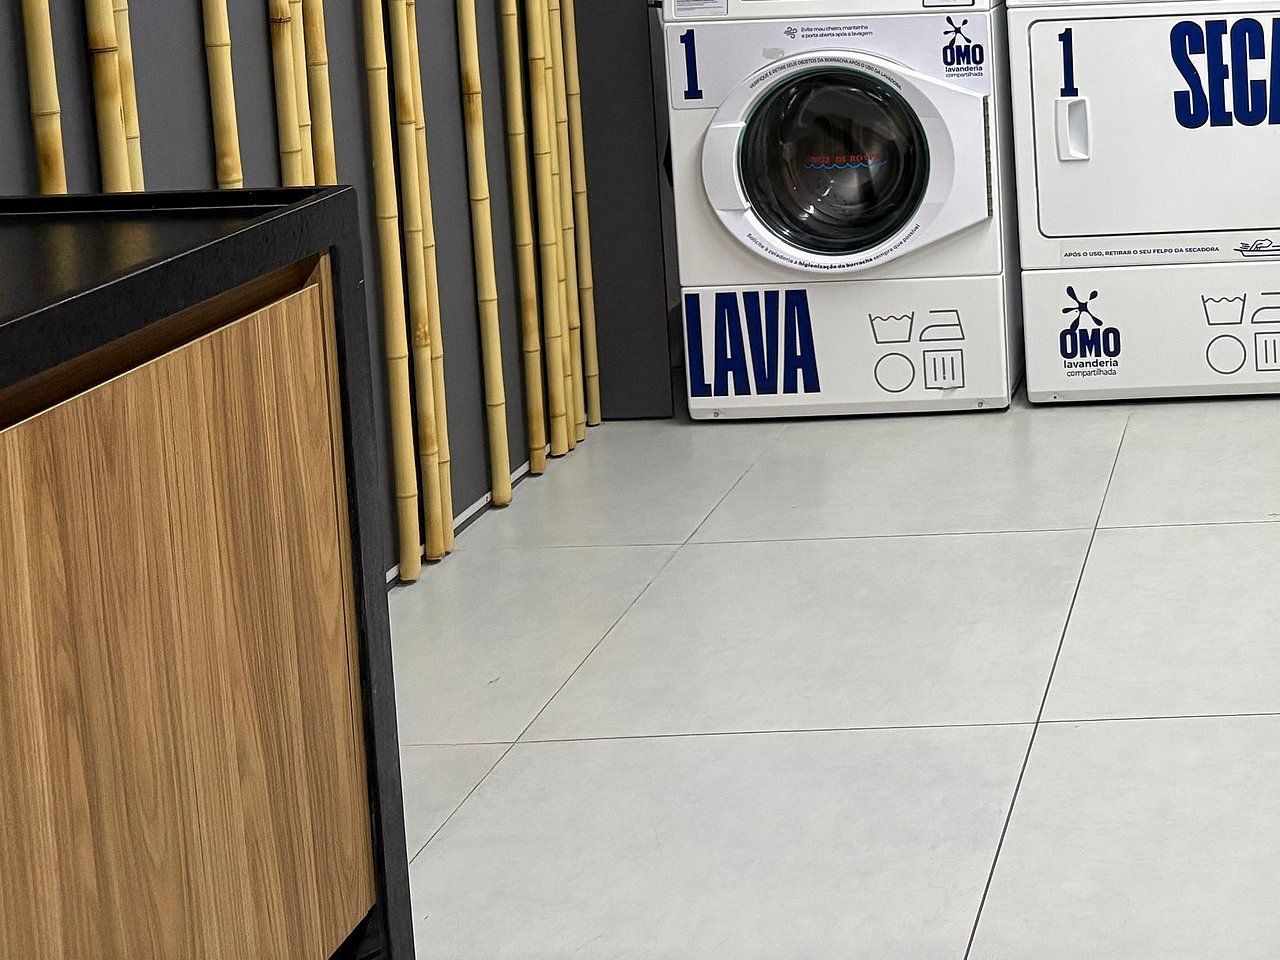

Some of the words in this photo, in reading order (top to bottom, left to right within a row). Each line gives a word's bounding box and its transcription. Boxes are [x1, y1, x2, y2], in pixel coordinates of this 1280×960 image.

[680, 28, 703, 100] 1
[942, 44, 984, 66] OMO
[1058, 27, 1079, 97] 1
[846, 257, 873, 268] borracha
[873, 247, 893, 260] sempre
[684, 288, 821, 398] LAVA
[1060, 326, 1121, 360] OMO
[1063, 358, 1119, 369] lavanderia
[1066, 368, 1117, 377] compartilhada
